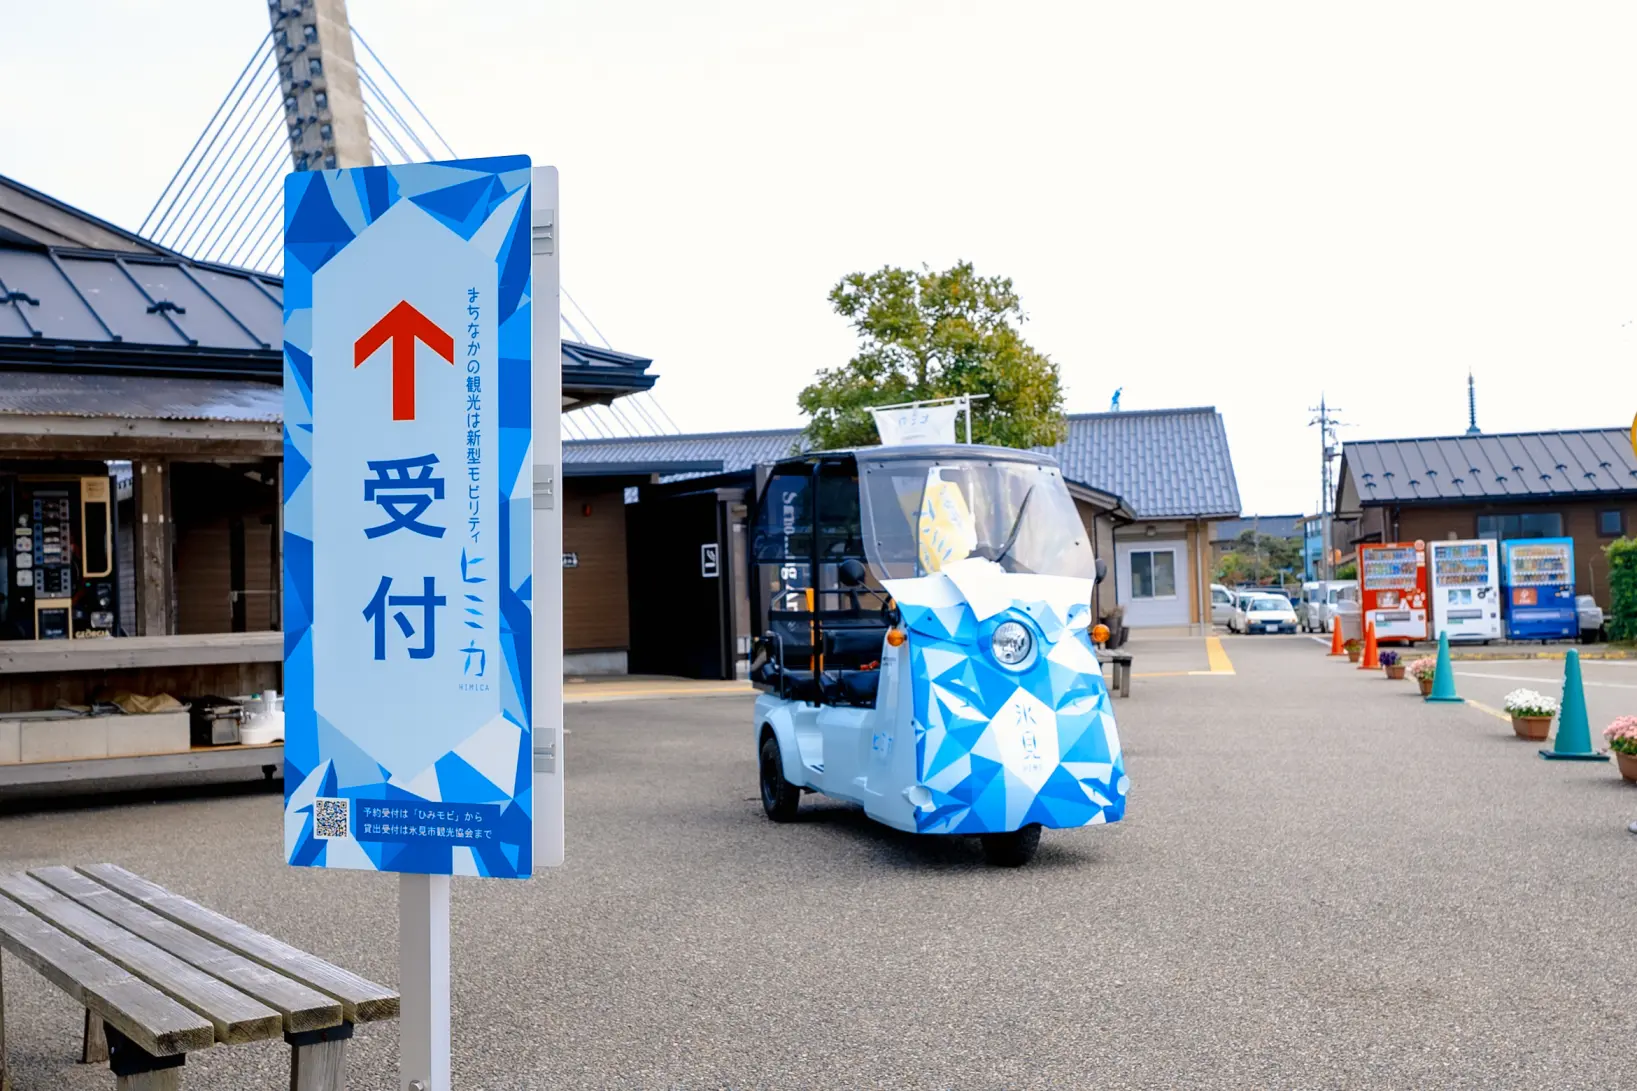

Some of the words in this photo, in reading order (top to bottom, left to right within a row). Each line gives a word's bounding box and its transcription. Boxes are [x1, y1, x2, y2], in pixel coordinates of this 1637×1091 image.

[466, 287, 482, 543] まちなかの観光は新型モビリティ
[362, 453, 447, 660] 受付
[458, 546, 488, 677] ヒミカ
[458, 683, 490, 692] HIMICA
[363, 807, 483, 823] 予約受付は「ひみモビ」から
[363, 823, 493, 840] 貸出受付は氷見市観光協会まで
